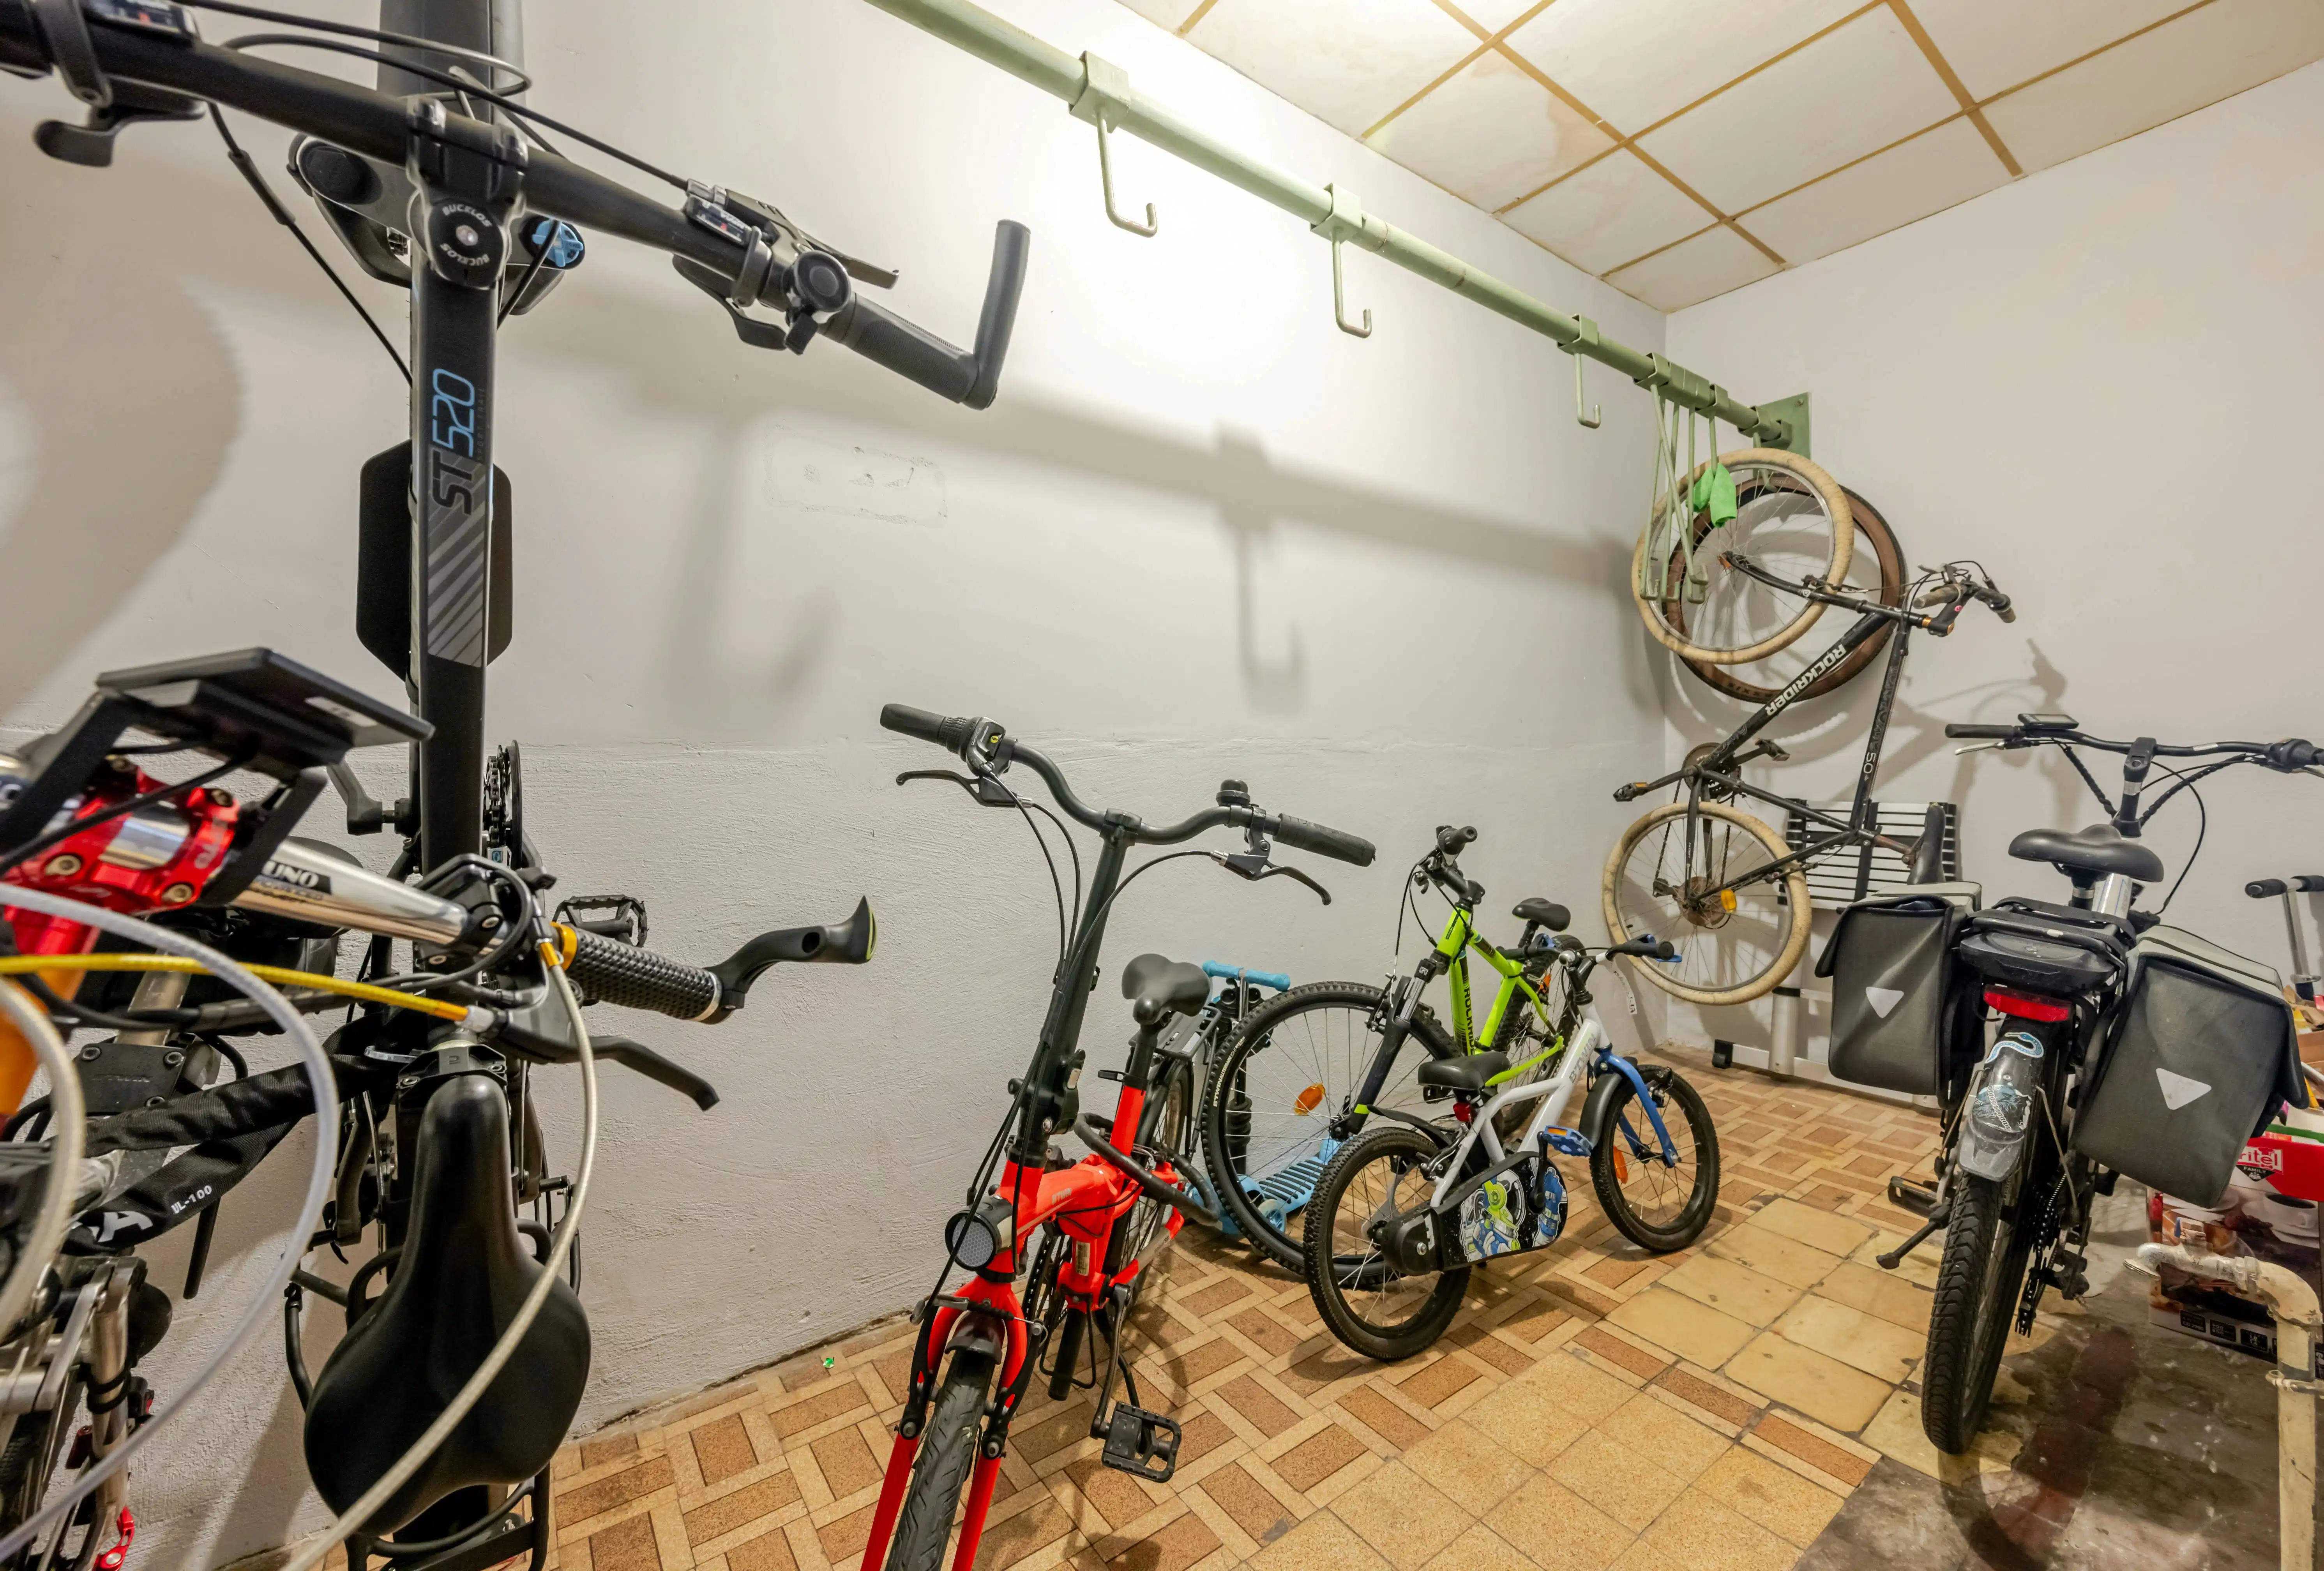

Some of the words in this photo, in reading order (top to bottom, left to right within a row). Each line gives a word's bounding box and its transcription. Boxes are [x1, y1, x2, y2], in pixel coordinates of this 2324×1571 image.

[442, 204, 493, 228] BUCKLOS
[440, 243, 490, 266] BUCKLOS
[432, 368, 475, 458] 520
[432, 449, 473, 515] ST
[1765, 644, 1847, 716] ROCKRIDER
[261, 860, 319, 888] UNO
[171, 1185, 212, 1214] UL-100
